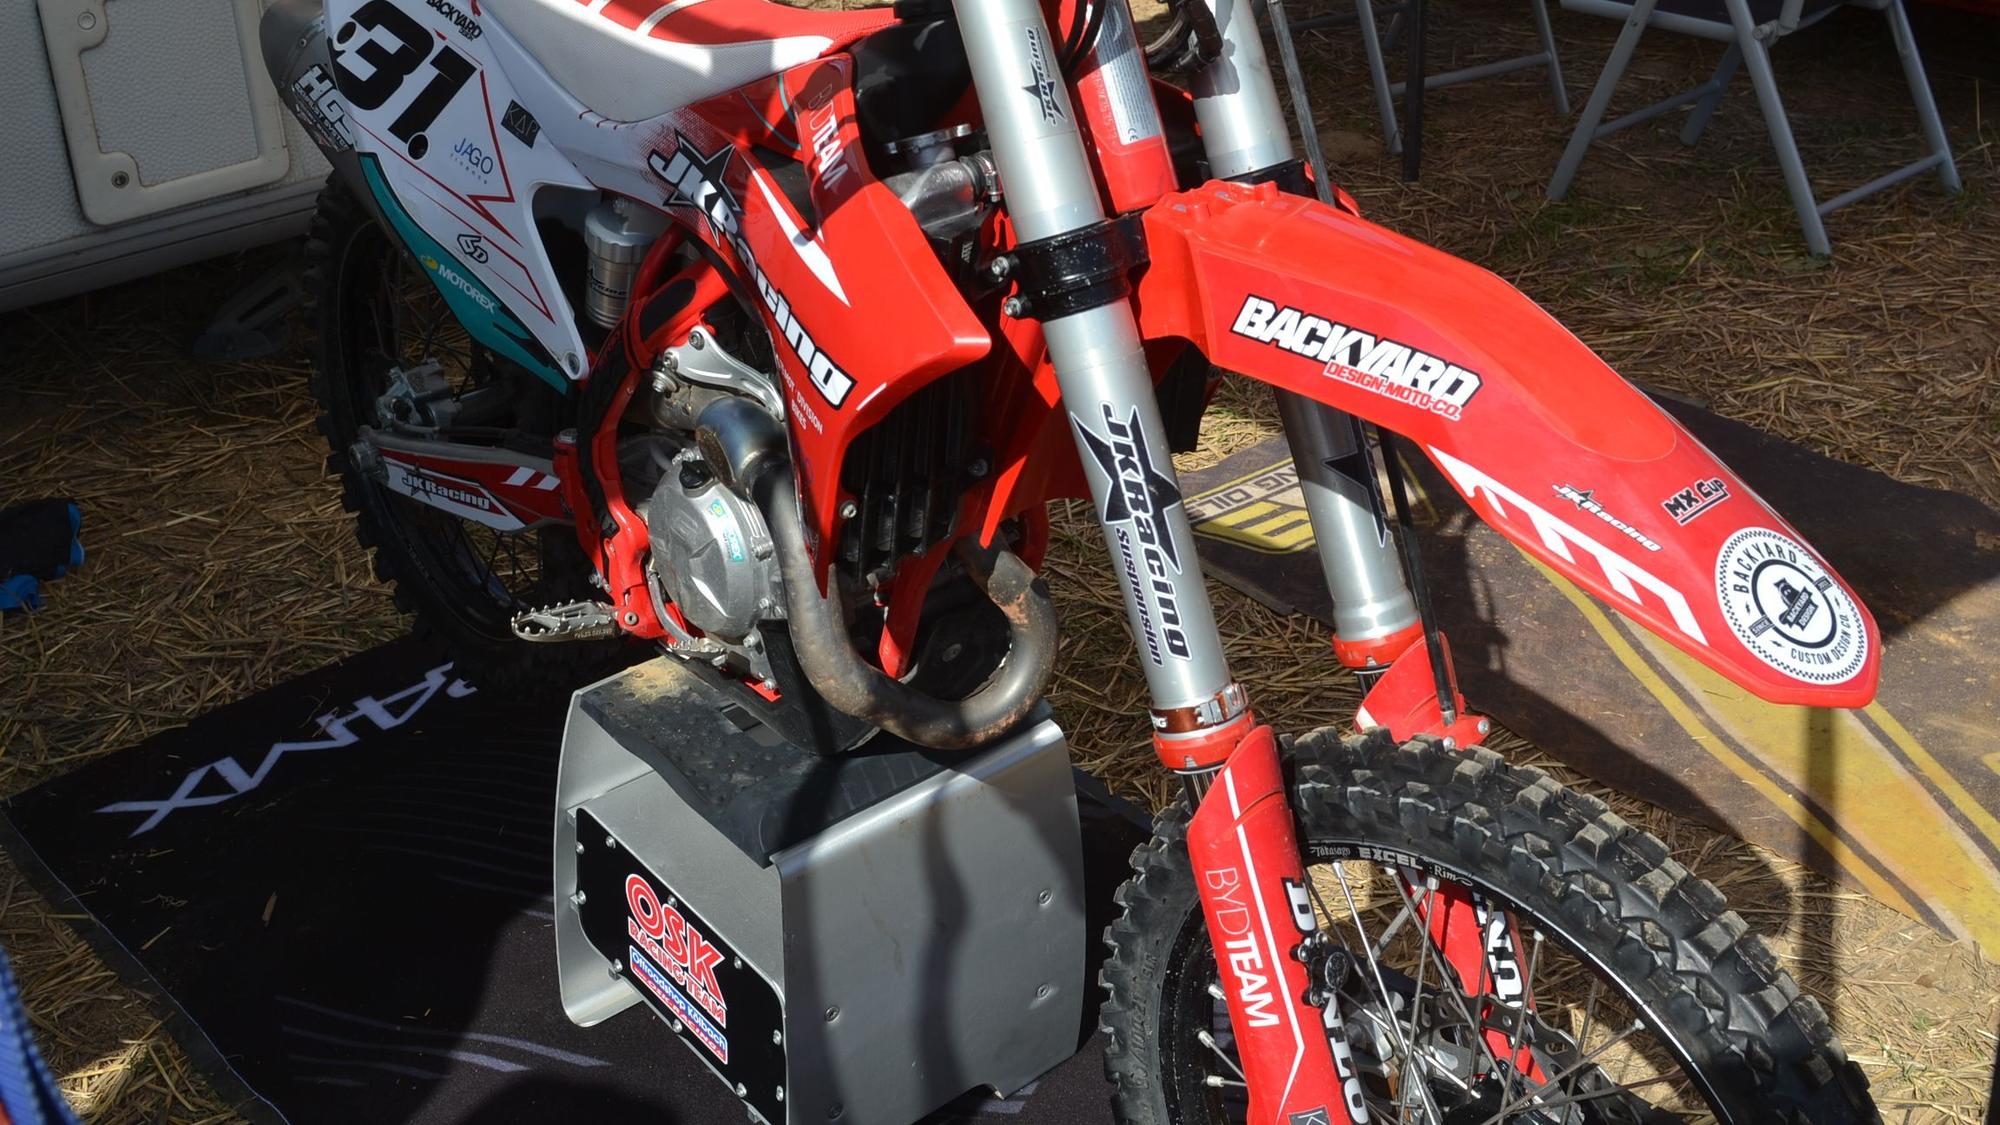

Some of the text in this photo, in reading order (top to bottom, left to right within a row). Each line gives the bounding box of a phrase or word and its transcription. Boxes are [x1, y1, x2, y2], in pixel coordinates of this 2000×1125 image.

[454, 138, 494, 176] JAGO
[438, 264, 499, 311] MOTOREX
[1231, 294, 1483, 407] BACKYARD
[1205, 488, 1248, 513] OIL
[1663, 490, 1701, 518] MX
[1733, 541, 1797, 594] BACKYARD
[1115, 526, 1164, 667] Suspension
[1790, 647, 1833, 666] CUSTOM
[1831, 630, 1852, 661] DESIGN
[1358, 846, 1423, 870] EXCEL
[626, 873, 727, 1010] OSK
